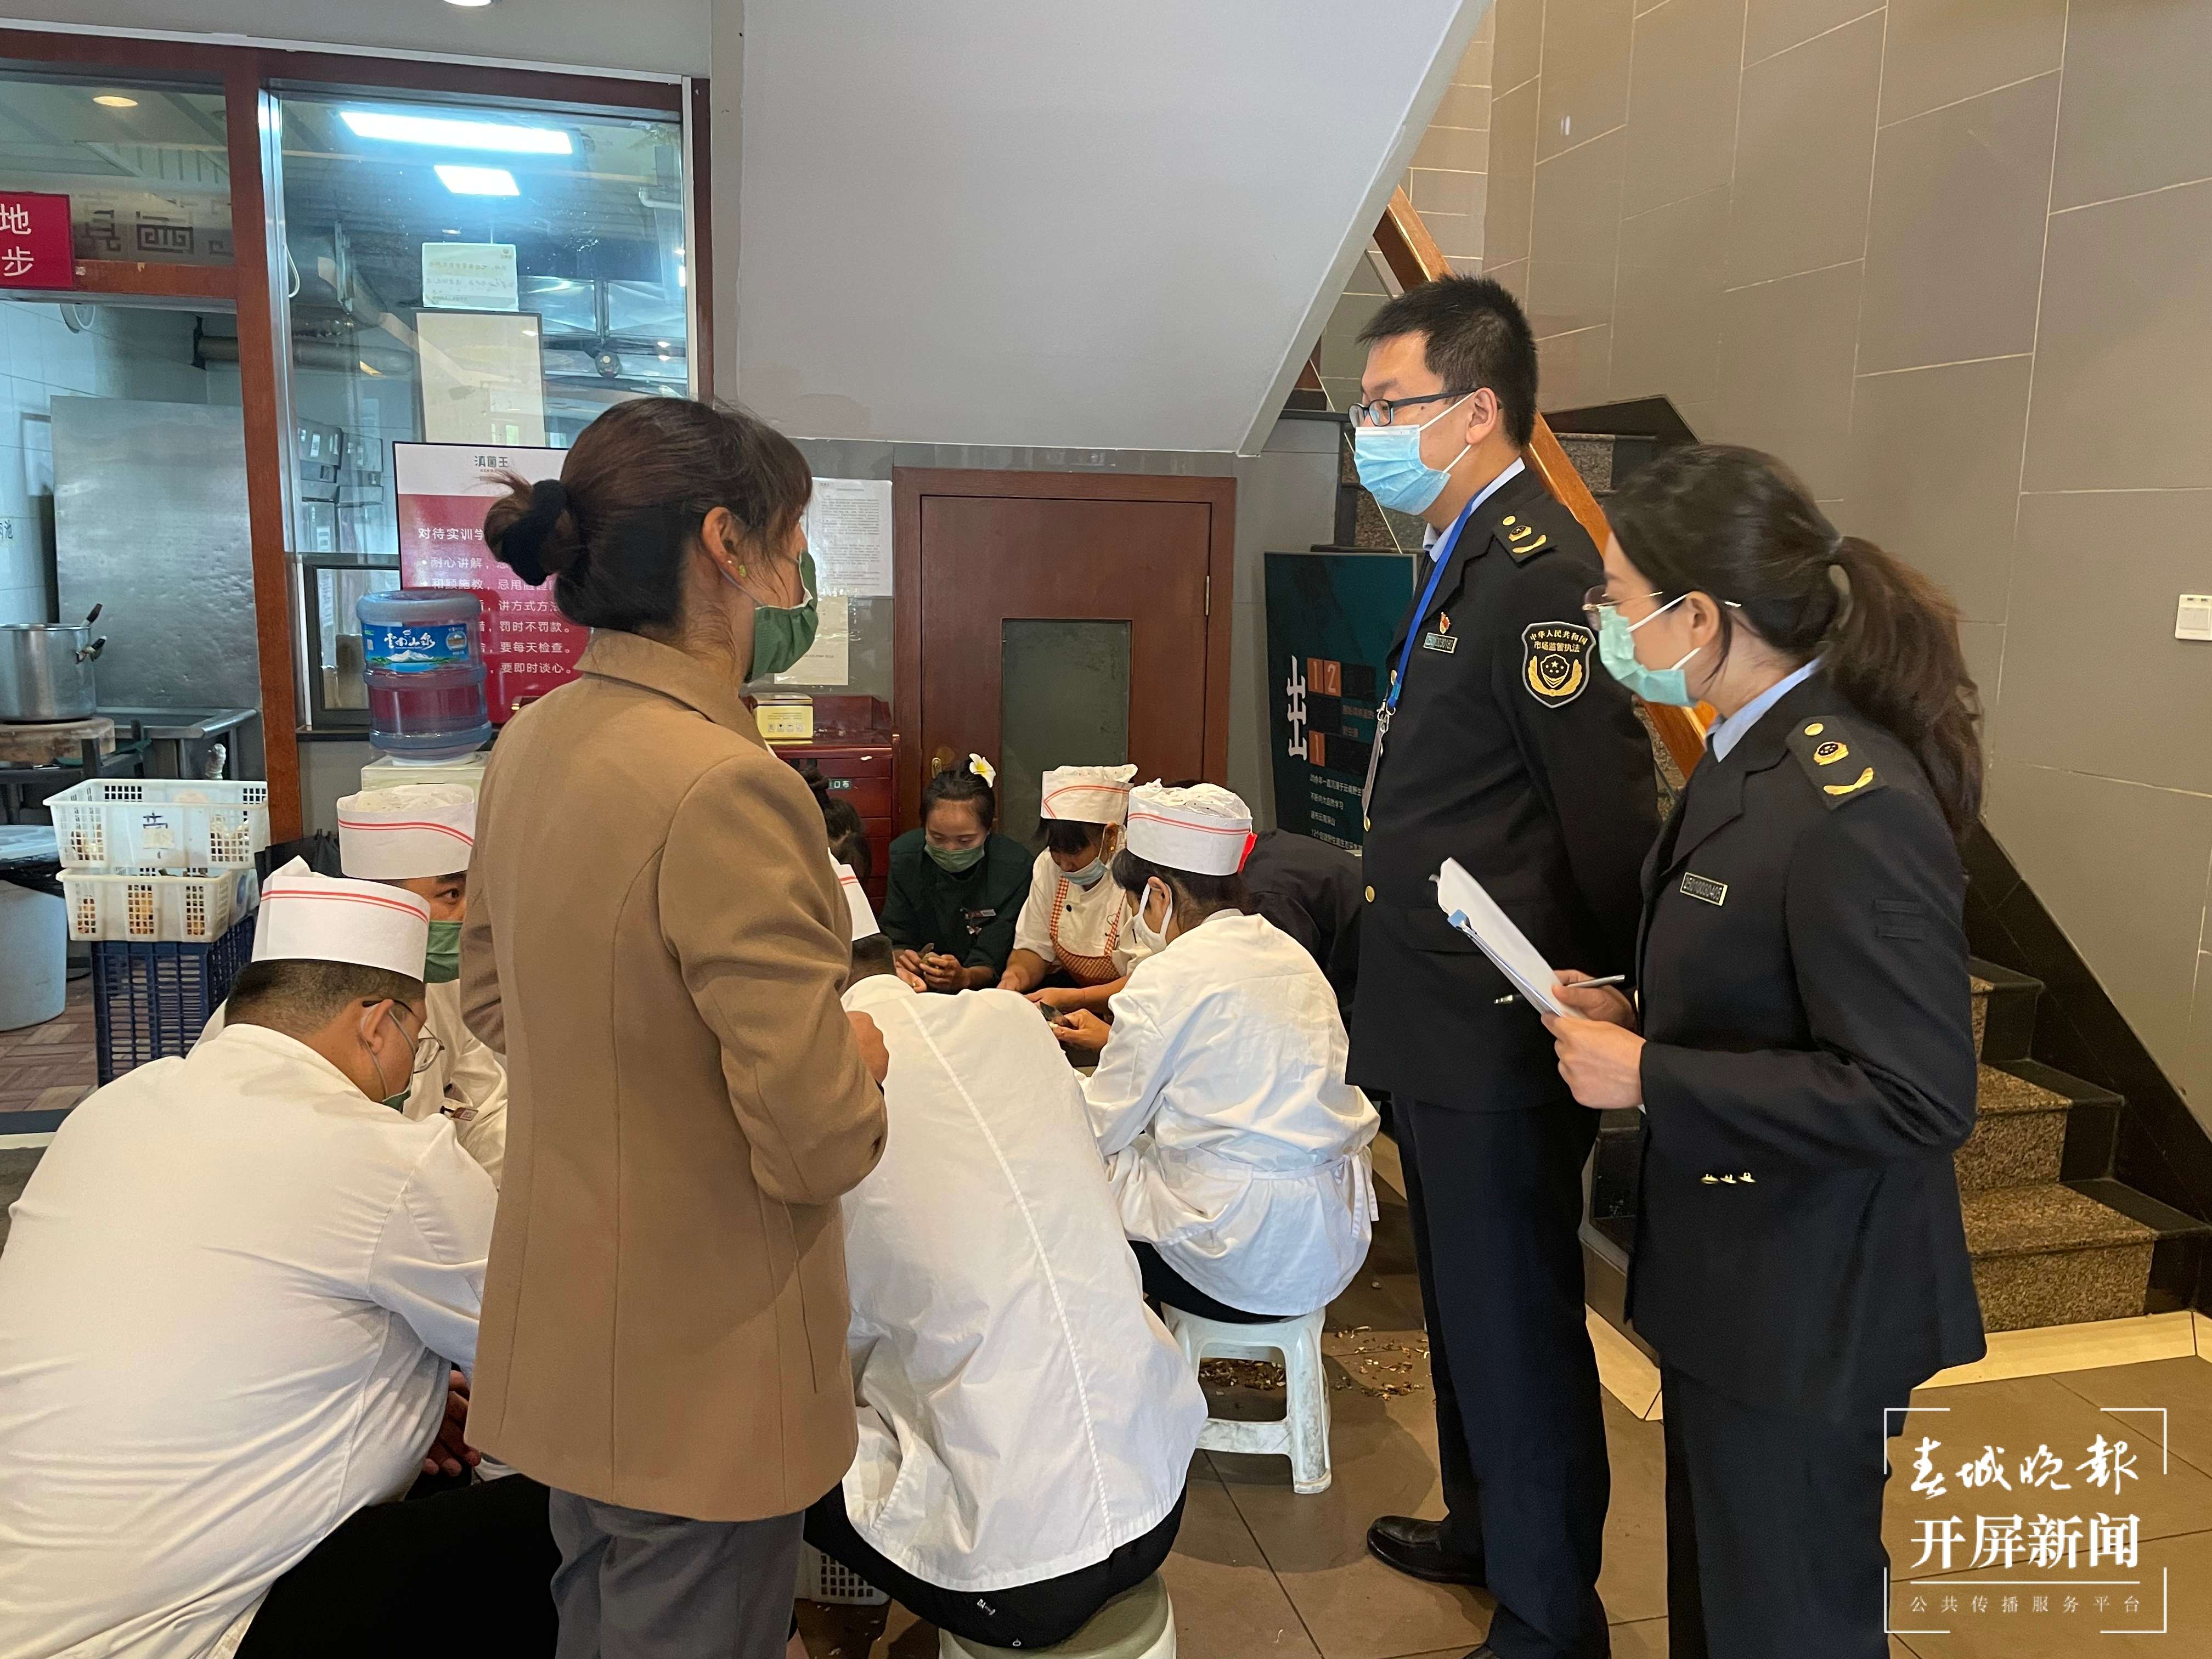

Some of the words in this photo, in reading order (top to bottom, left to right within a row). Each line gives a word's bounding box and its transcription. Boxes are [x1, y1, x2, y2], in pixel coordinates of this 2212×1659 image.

[2, 246, 35, 276] 步
[474, 455, 509, 468] 滇菌王
[1530, 629, 1588, 645] 中华人民共和国
[1534, 641, 1580, 653] 市场监管执法
